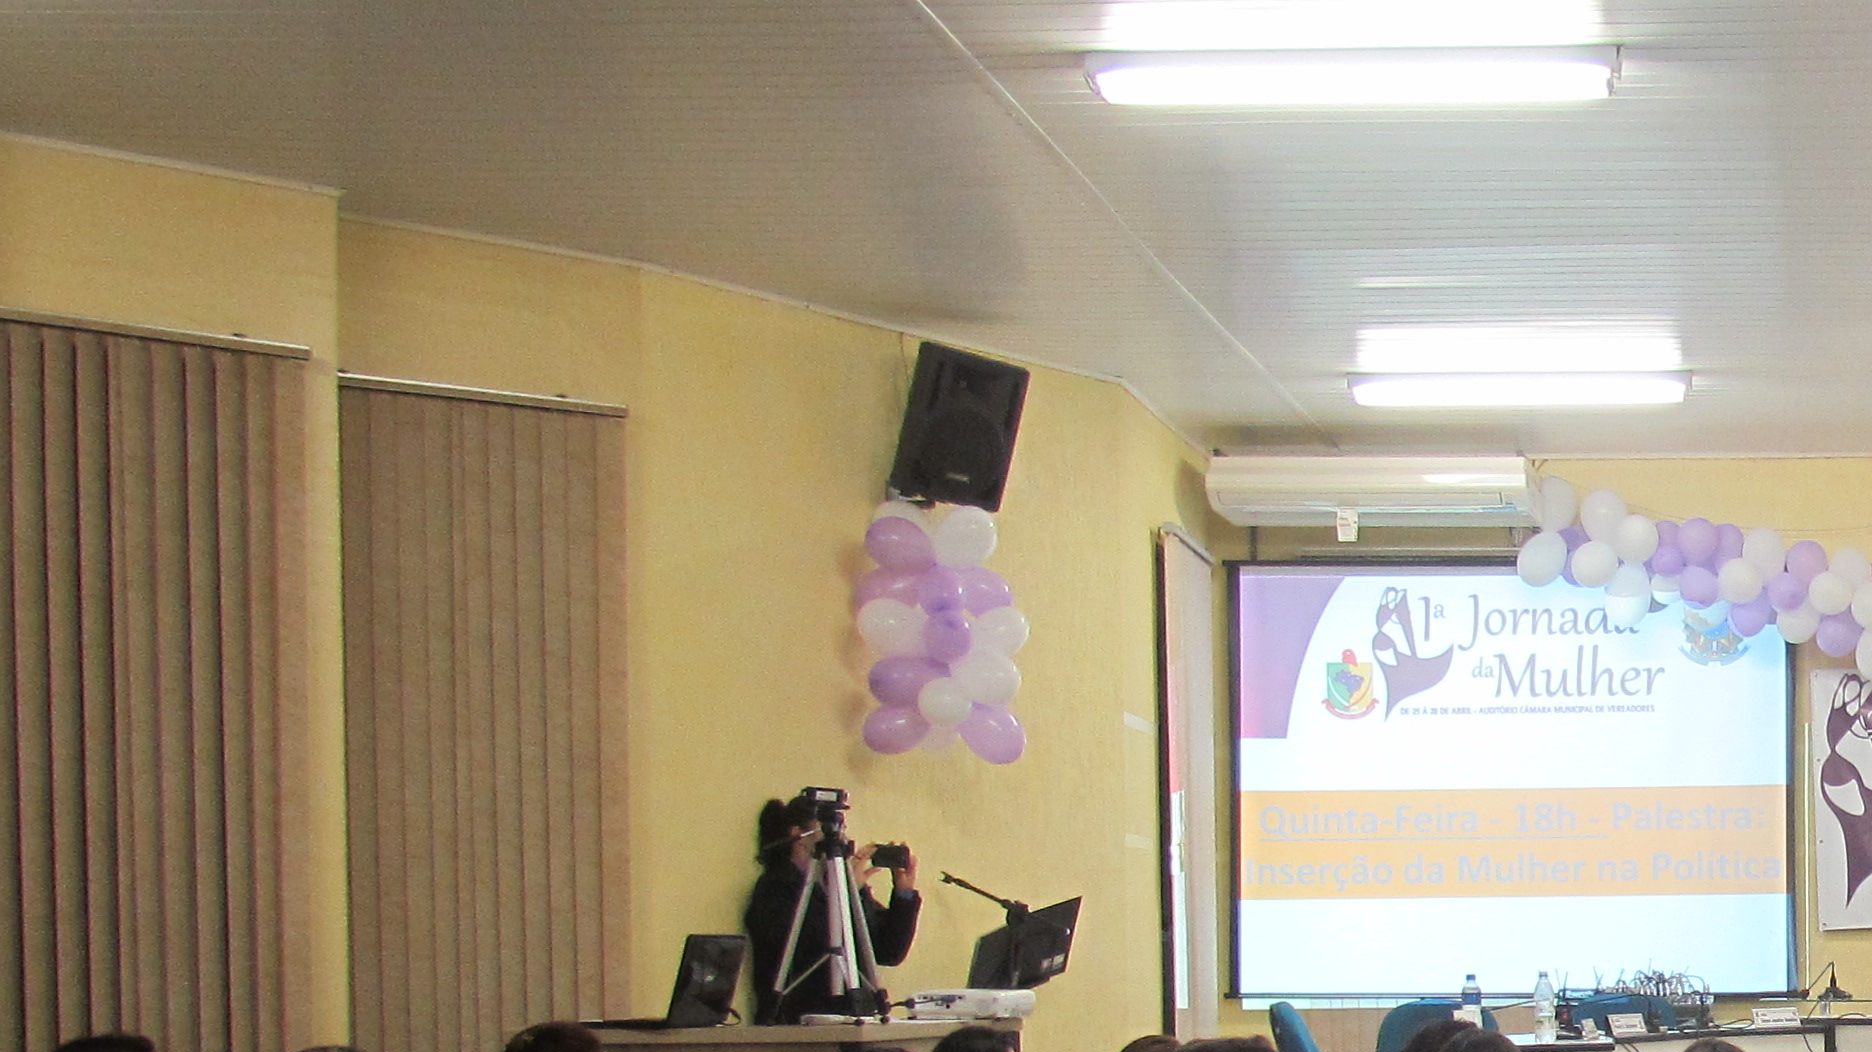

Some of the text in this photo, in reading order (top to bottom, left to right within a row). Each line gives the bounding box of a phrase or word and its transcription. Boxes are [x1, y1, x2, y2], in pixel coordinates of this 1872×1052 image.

[1471, 644, 1665, 698] da Mulher
[1553, 705, 1593, 713] MUNICIPAL
[1595, 705, 1605, 713] DE
[1607, 704, 1655, 713] VEREADORES
[1259, 804, 1479, 839] Quinta-Feira
[1514, 802, 1578, 832] 18h
[1612, 801, 1766, 831] Palestra:
[1245, 850, 1782, 892] Inserção da Mulher na Política
